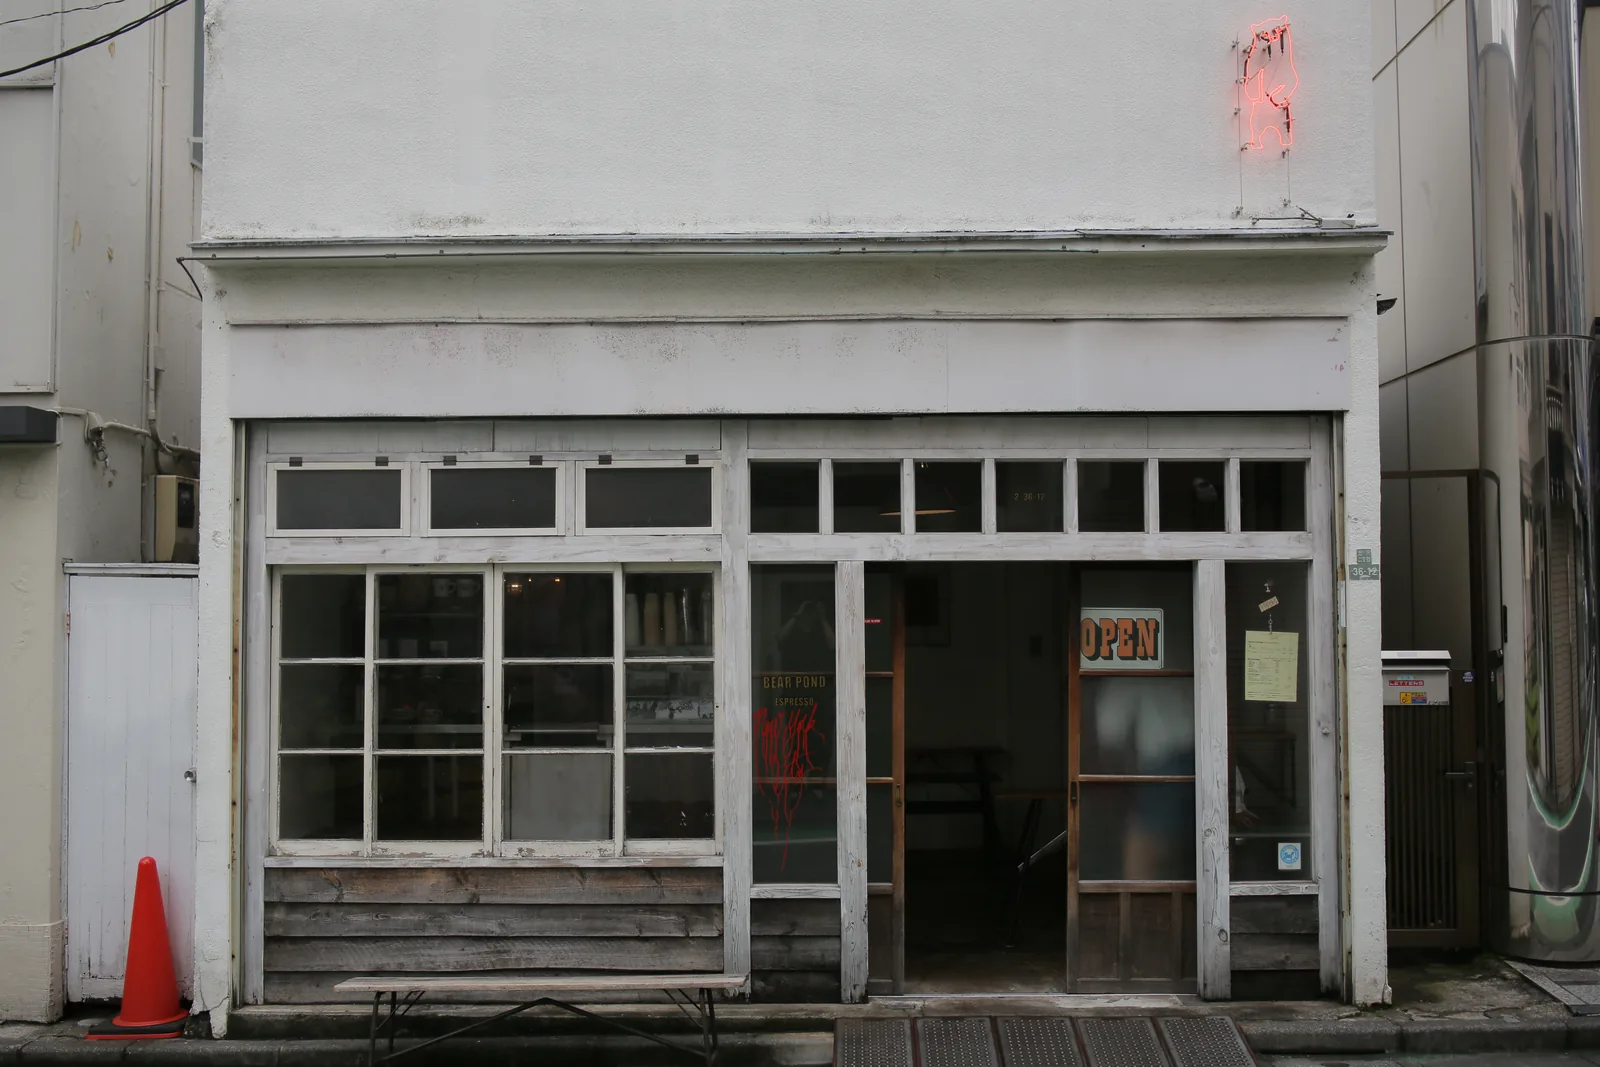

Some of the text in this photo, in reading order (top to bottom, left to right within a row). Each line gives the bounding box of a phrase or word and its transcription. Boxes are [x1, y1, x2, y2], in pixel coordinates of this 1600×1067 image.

[1081, 618, 1159, 661] OPEN
[764, 676, 826, 688] BEAR POND
[775, 697, 815, 707] ESPRESSO
